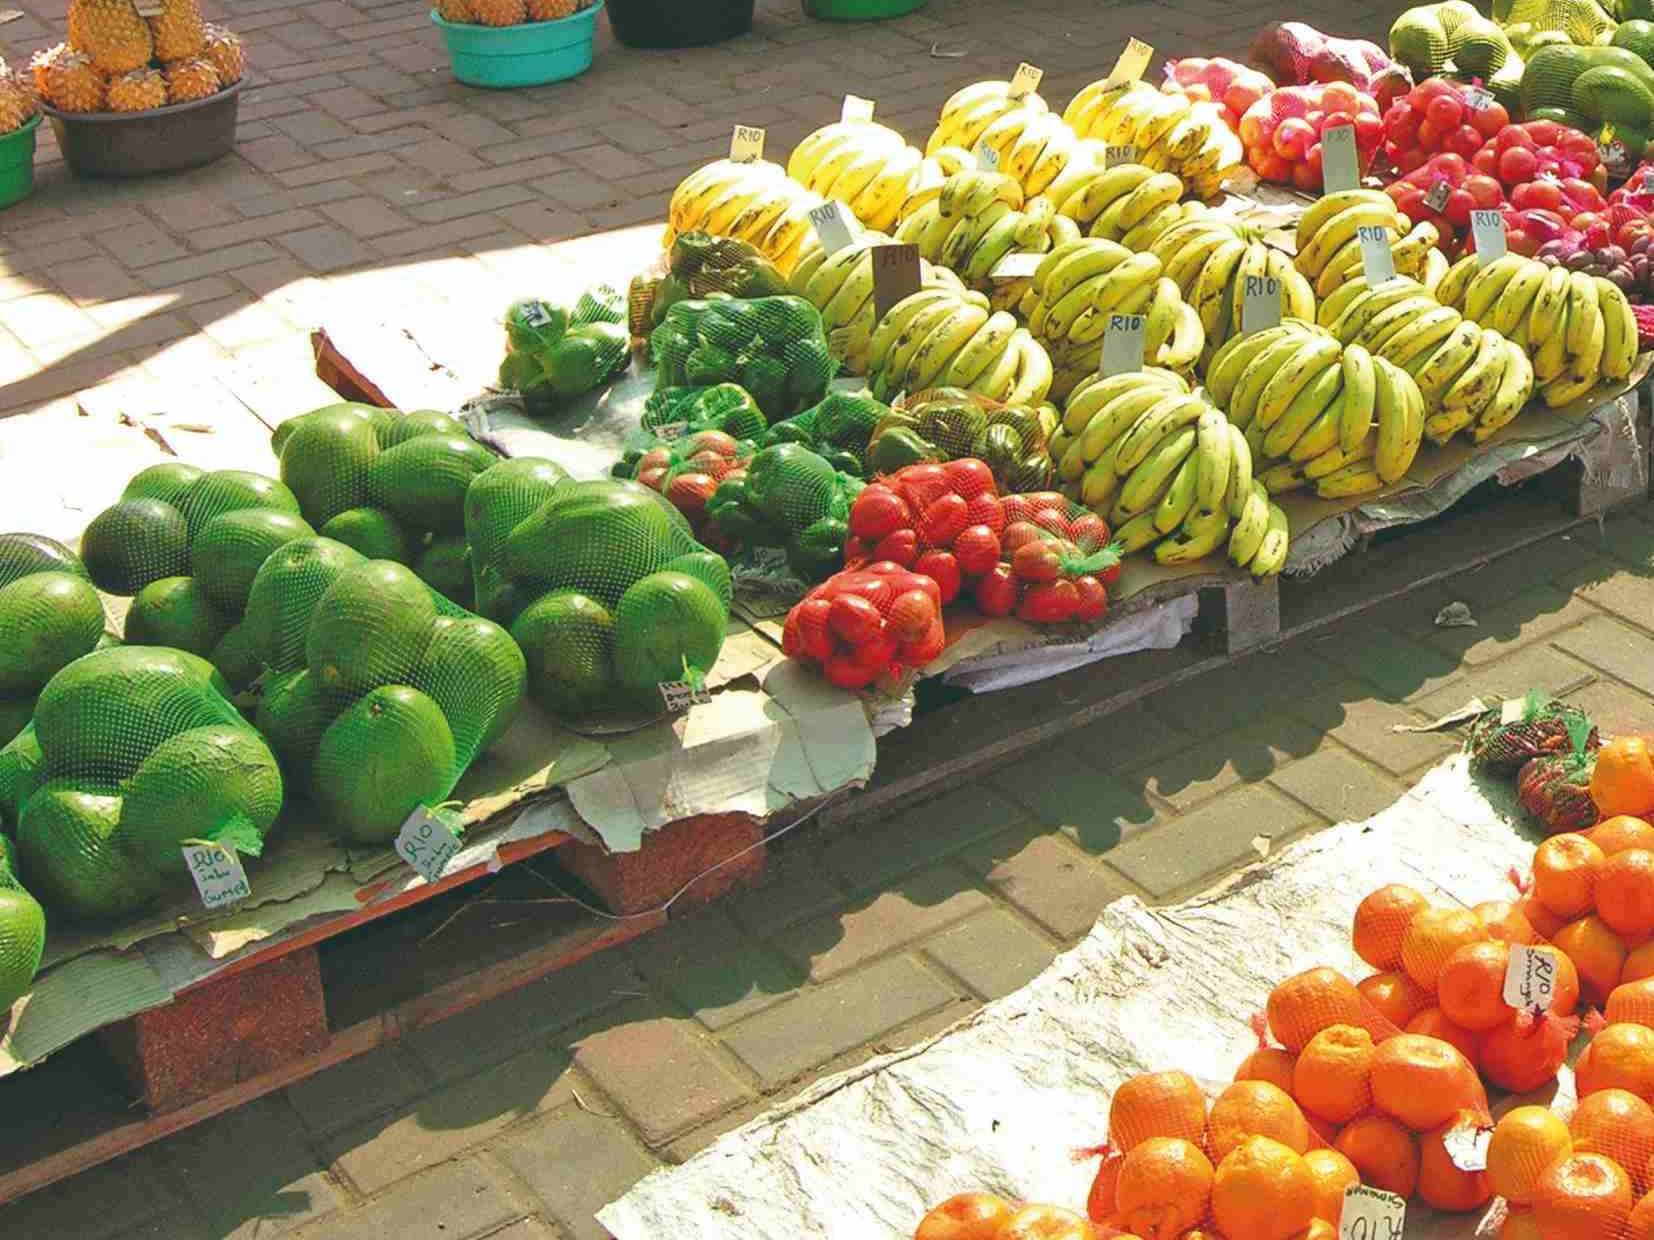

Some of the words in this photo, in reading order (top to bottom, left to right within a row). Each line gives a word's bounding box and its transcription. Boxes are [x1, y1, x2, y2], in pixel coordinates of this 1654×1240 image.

[738, 127, 761, 142] R10
[1106, 146, 1131, 161] R10
[809, 204, 834, 225] R10
[1475, 211, 1500, 227] R10
[1359, 226, 1382, 243] R10
[883, 246, 913, 267] R10
[1246, 275, 1276, 296] R10
[1111, 315, 1140, 331] R10
[404, 825, 432, 862] R10
[193, 850, 225, 871] R10
[1535, 954, 1552, 994] R10
